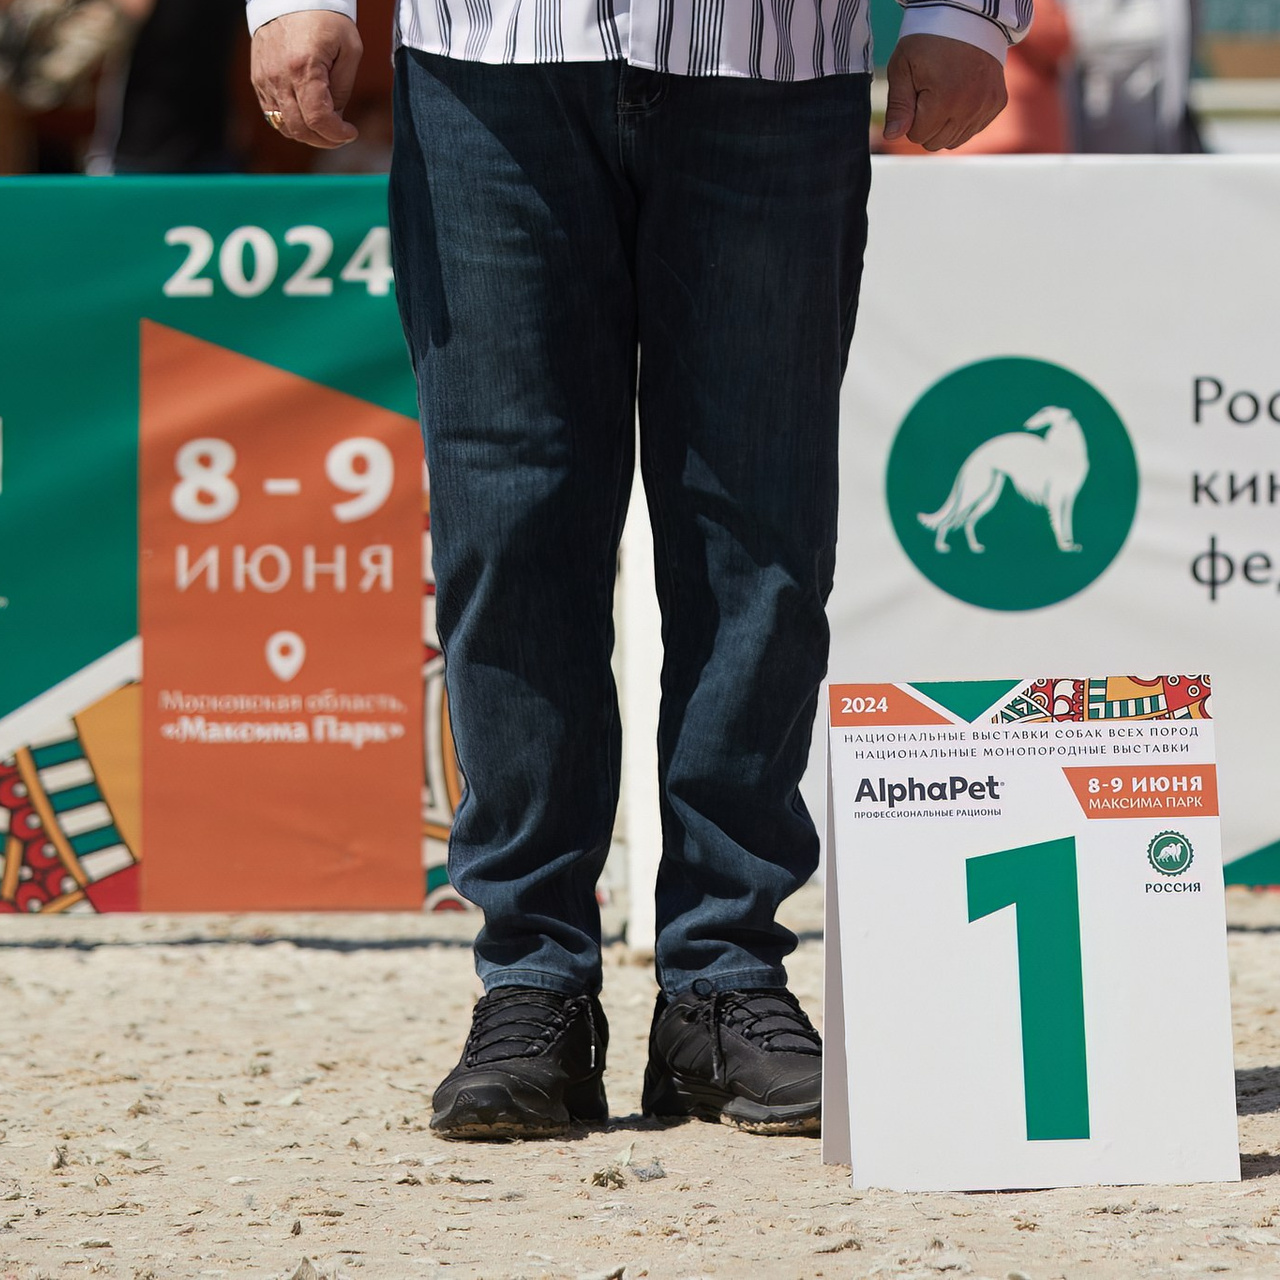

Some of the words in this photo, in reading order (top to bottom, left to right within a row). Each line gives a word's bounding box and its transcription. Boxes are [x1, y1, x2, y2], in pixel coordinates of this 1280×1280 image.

[163, 225, 395, 297] 2024
[175, 544, 394, 593] ИЮНЯ
[841, 697, 888, 714] 2024
[844, 731, 966, 743] НАЦИОНАЛЬНЫЕ
[972, 730, 1049, 741] ВЫСТАВКИ
[1055, 729, 1102, 739] СОБАК
[1108, 728, 1144, 738] ВСЕХ
[1150, 726, 1199, 737] ПОРОД
[855, 747, 977, 760] НАЦИОНАЛЬНЫЕ
[983, 745, 1107, 757] МОНОПОРОДНЫЕ
[1113, 743, 1190, 754] ВЫСТАВКИ
[1088, 777, 1123, 794] 8-9
[1131, 776, 1203, 793] ИЮНЯ
[1089, 797, 1162, 810] МАКСИМА
[1166, 796, 1203, 808] ПАРК
[854, 809, 953, 819] ПРОФЕССИОНАЛЬНЫЕ
[956, 808, 1001, 817] РАЦИОНЫ
[1145, 881, 1201, 894] РОССИЯ
[965, 835, 1090, 1142] 1
